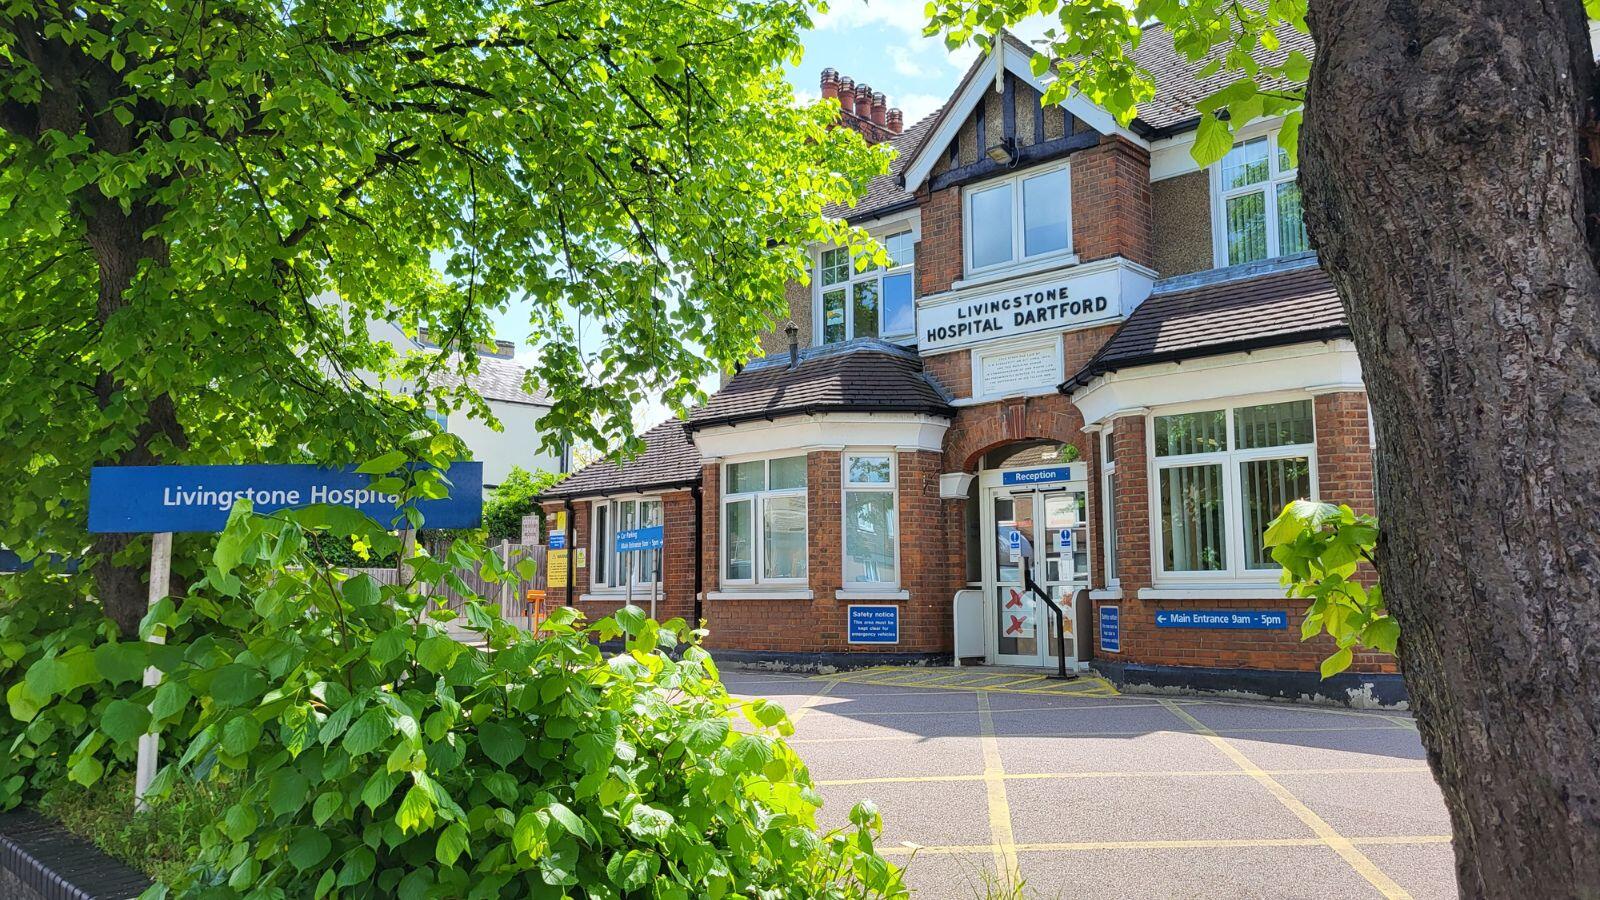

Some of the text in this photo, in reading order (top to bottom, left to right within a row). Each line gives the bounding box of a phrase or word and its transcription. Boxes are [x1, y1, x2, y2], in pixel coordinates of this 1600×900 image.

[958, 287, 1068, 319] LIVINGSTONE
[927, 296, 1107, 342] HOSPITAL DARTFORD
[1015, 470, 1056, 481] Reception
[163, 485, 400, 510] Livingstone Hospita
[1170, 614, 1190, 623] Main
[1193, 614, 1229, 623] Entrance
[1231, 614, 1250, 624] 9am
[1261, 614, 1281, 626] 5pm
